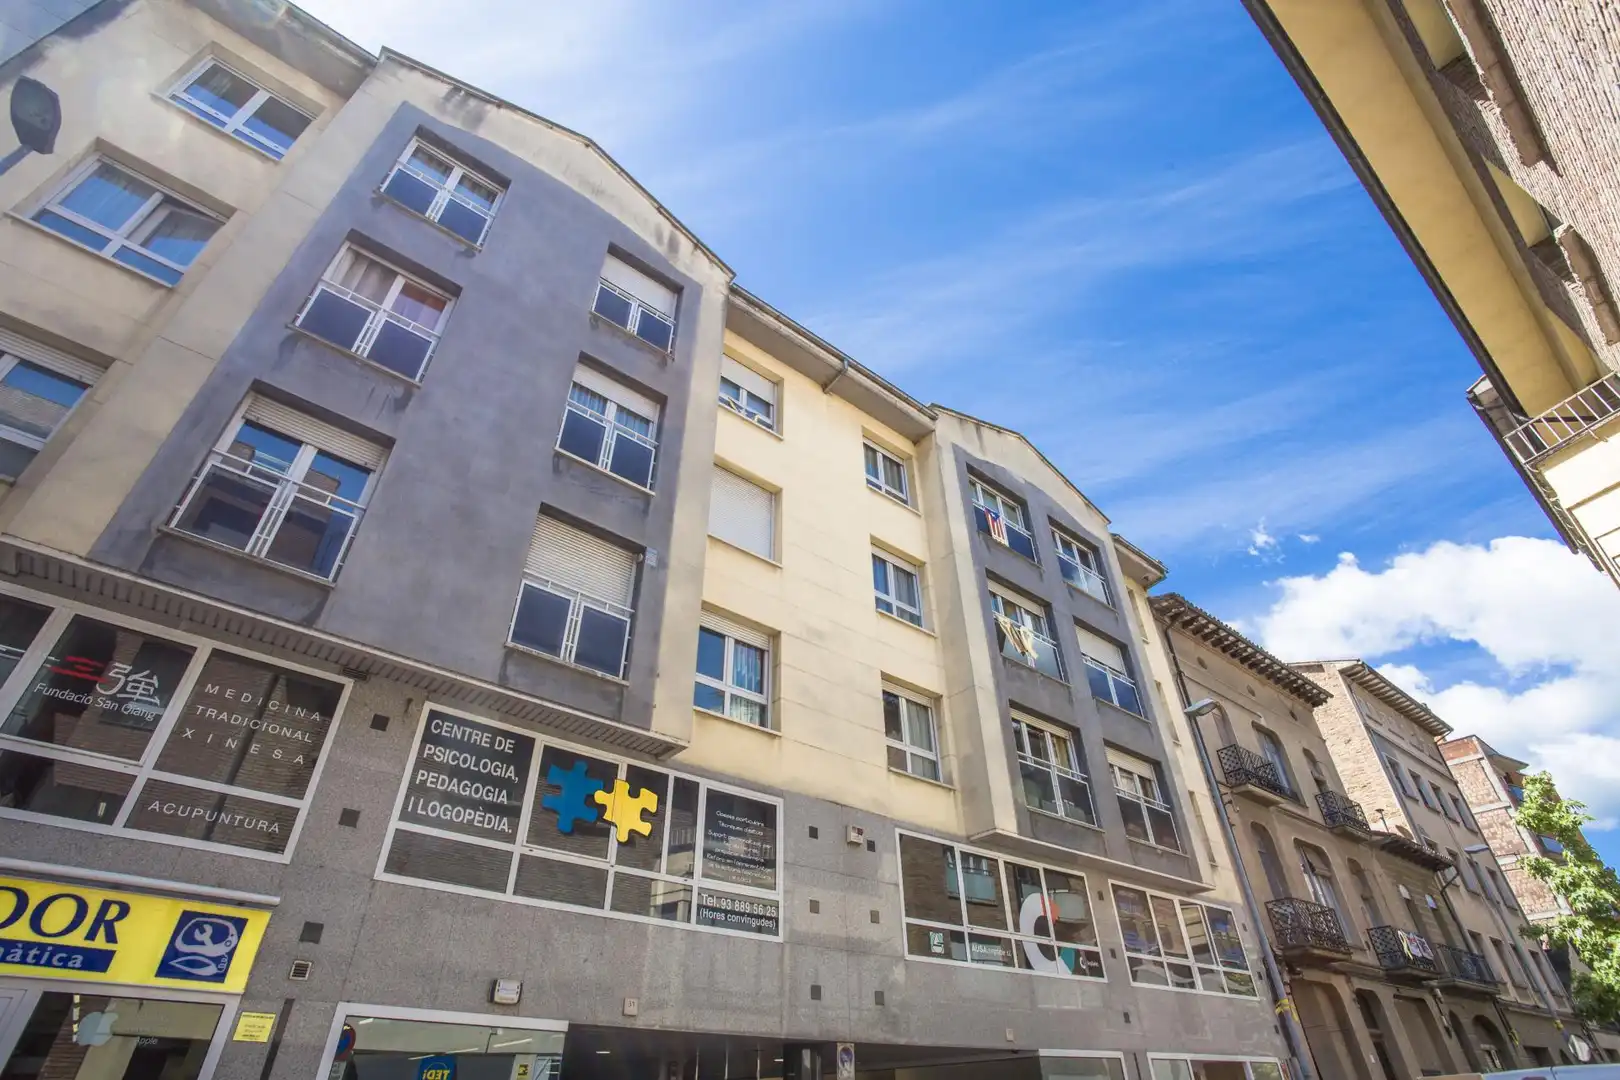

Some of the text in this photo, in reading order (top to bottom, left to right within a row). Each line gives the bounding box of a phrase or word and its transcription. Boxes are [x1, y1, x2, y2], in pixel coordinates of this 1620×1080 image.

[95, 696, 118, 711] San
[205, 683, 321, 722] MEDICINA
[196, 705, 312, 743] TRADICIONAL
[431, 719, 515, 754] CENTRE DE
[182, 727, 304, 765] XINESA
[423, 743, 519, 784] PSICOLOGIA,
[415, 769, 508, 805] PEDAGOGIA
[148, 800, 279, 833] ACUPUNTURA
[408, 796, 512, 833] I LOGOPÈDIA.
[700, 908, 726, 921] (Hores
[734, 900, 750, 913] 889
[753, 903, 764, 916] 56
[766, 905, 777, 918] 25
